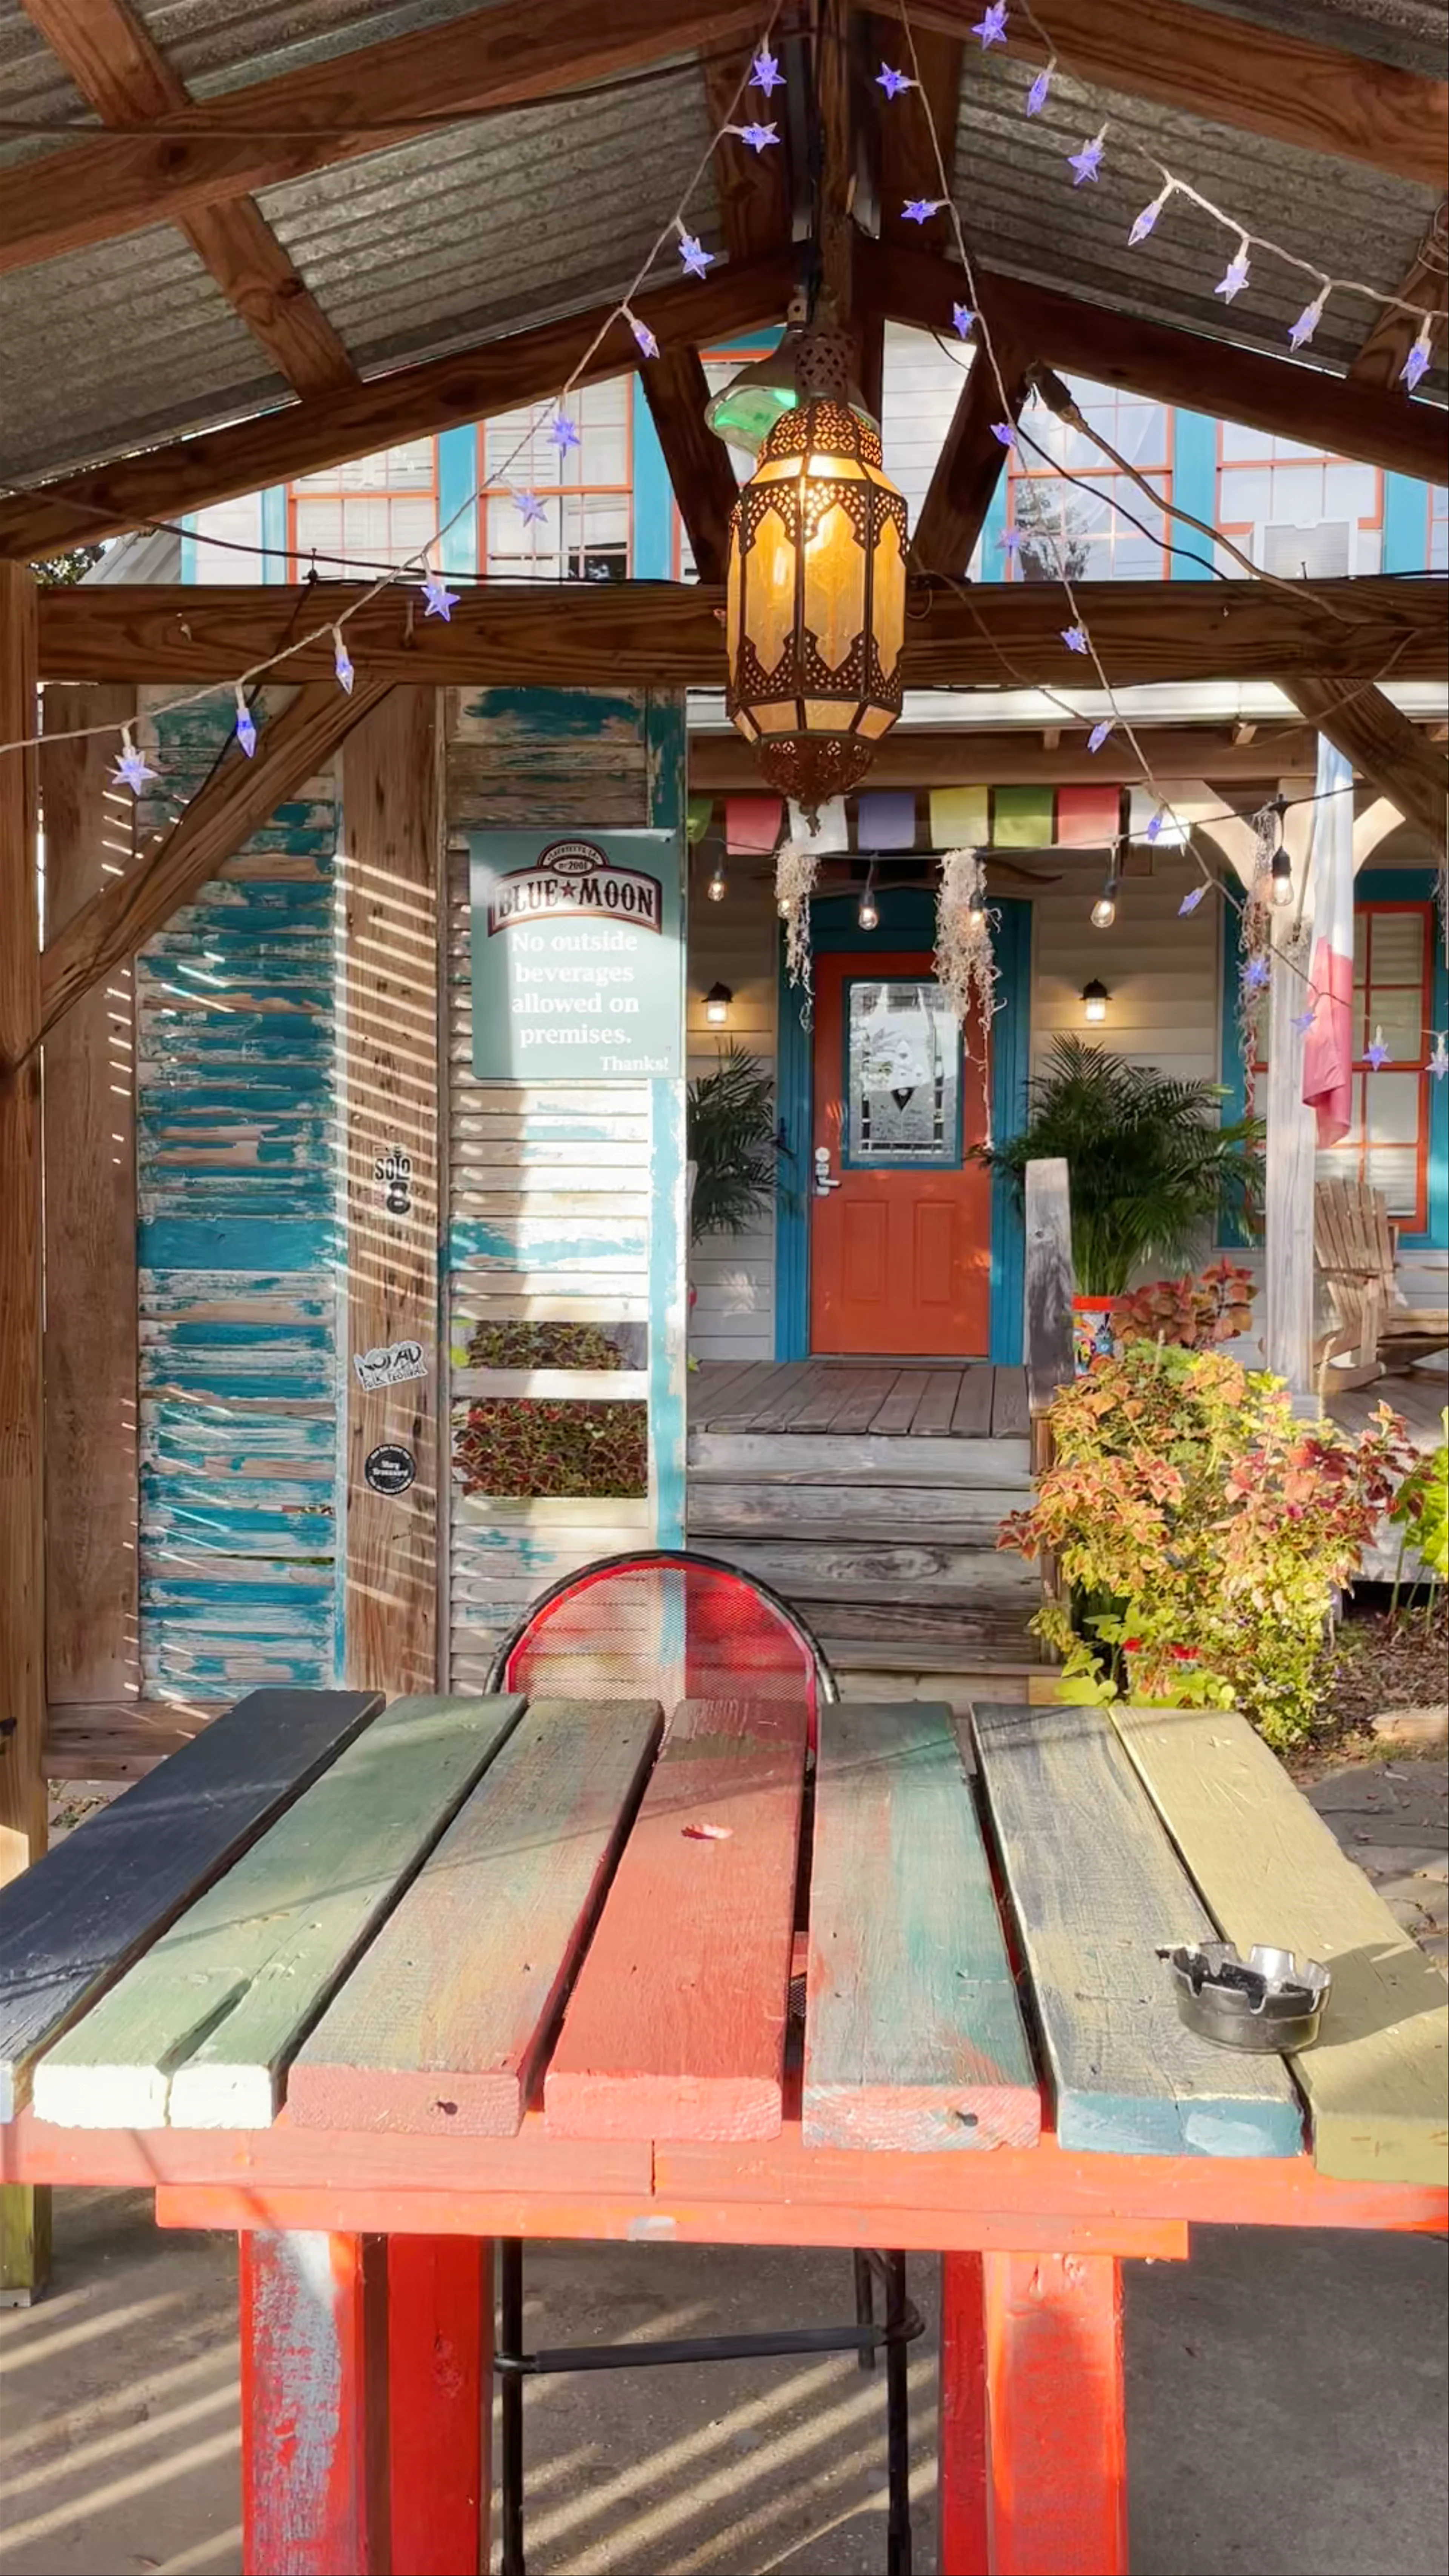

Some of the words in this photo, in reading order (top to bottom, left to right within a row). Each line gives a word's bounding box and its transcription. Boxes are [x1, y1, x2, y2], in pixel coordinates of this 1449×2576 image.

[499, 879, 558, 918] BLUE
[578, 878, 653, 917] MOON
[512, 932, 545, 952] No
[551, 930, 638, 952] outside
[514, 962, 635, 987] beverages
[512, 992, 603, 1013] allowed
[609, 997, 640, 1013] on
[519, 1023, 632, 1048] premises.
[599, 1055, 669, 1071] Thanks!
